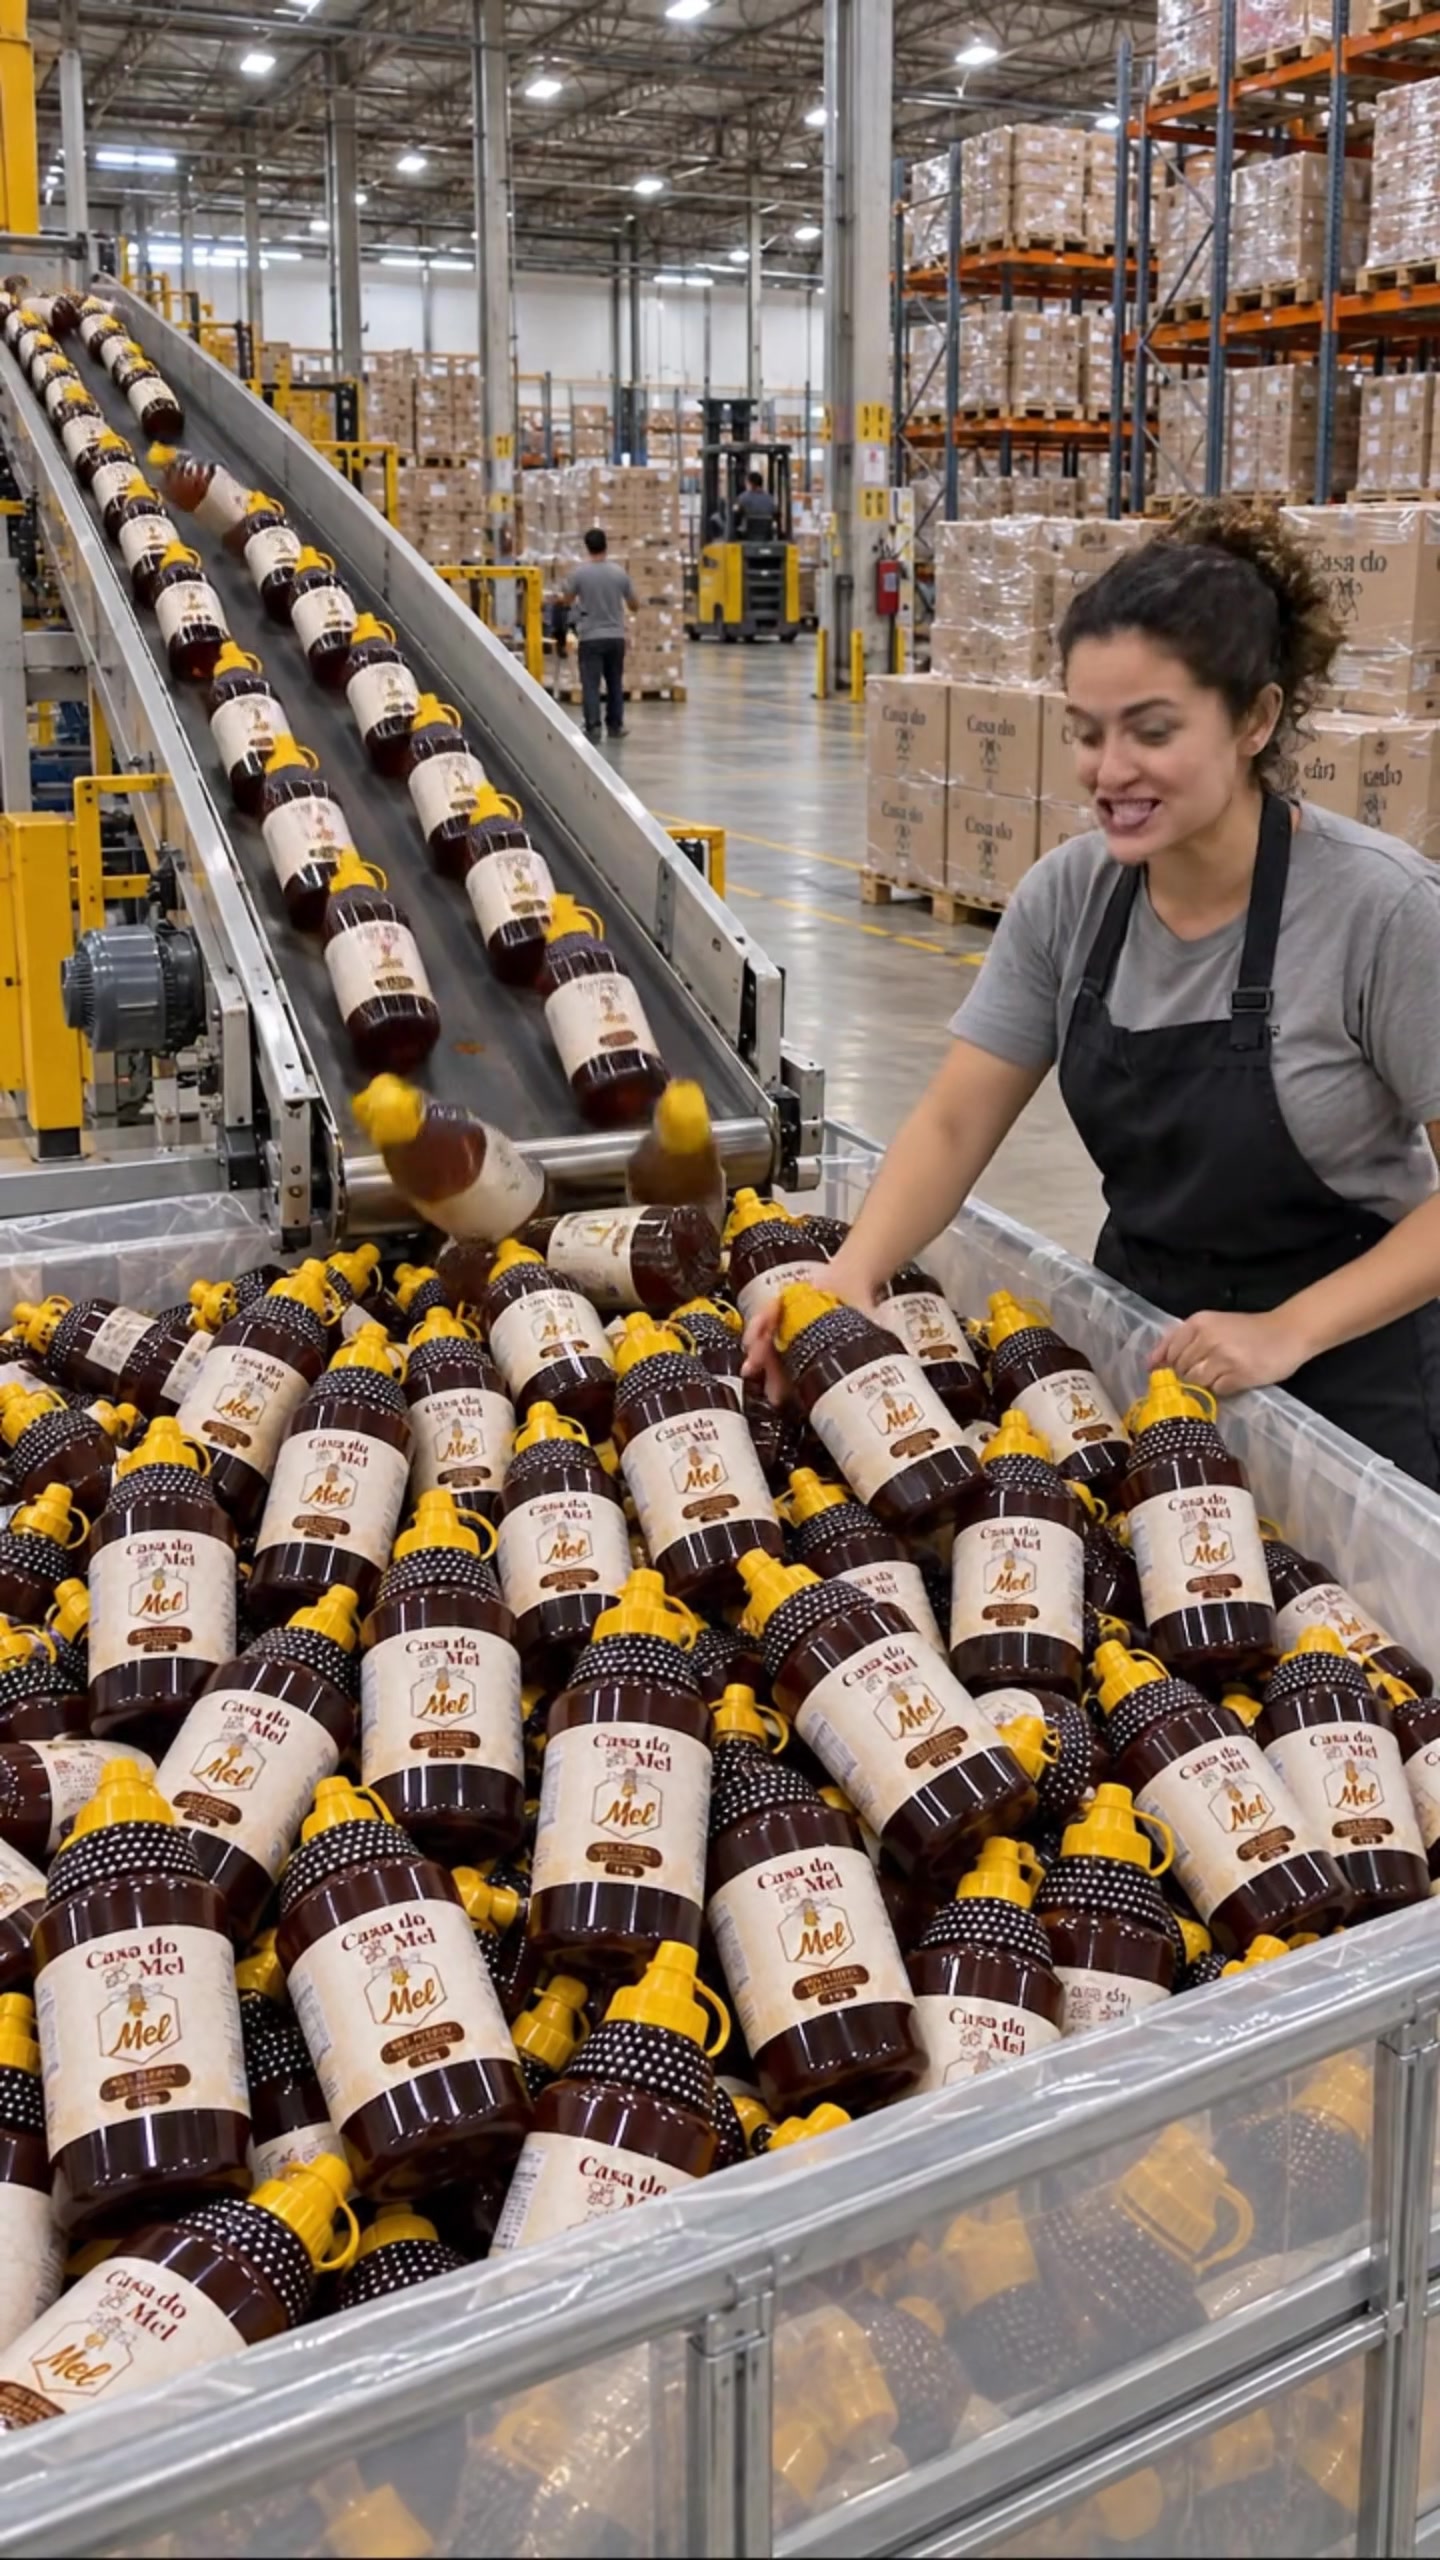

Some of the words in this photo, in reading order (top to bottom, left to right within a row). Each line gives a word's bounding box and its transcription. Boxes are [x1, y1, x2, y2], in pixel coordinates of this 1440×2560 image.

[1361, 549, 1387, 573] do
[683, 1463, 722, 1493] Mel
[304, 1484, 352, 1506] Mel
[545, 1538, 587, 1565] Mel
[1190, 1541, 1230, 1566] Mel
[989, 1571, 1031, 1594] Mel
[136, 1591, 184, 1617] Mel
[405, 1637, 449, 1654] Casa
[453, 1636, 478, 1650] do
[445, 1650, 480, 1667] Mel
[221, 1699, 262, 1719] Casa
[265, 1707, 291, 1729] do
[418, 1692, 469, 1719] Mel
[897, 1694, 937, 1738] Mel
[247, 1719, 288, 1745] Mel
[593, 1732, 641, 1750] Casa
[645, 1735, 670, 1754] do
[1309, 1732, 1350, 1747] Casa
[1353, 1730, 1374, 1745] do
[191, 1757, 254, 1787] Mel
[633, 1751, 672, 1773] Mel
[1334, 1783, 1378, 1808] Mel
[597, 1798, 656, 1828] Mel
[1229, 1794, 1268, 1832] Mel
[757, 1865, 805, 1890] Casa
[809, 1857, 835, 1873] do
[804, 1872, 844, 1893] Mel
[340, 1922, 393, 1952] Casa
[398, 1911, 426, 1930] do
[393, 1927, 437, 1952] Mel
[794, 1921, 846, 1962] Mel
[85, 1944, 141, 1971] Casa
[148, 1936, 178, 1955] do
[138, 1955, 186, 1977] Mel
[382, 1978, 437, 2024] Mel
[108, 2013, 172, 2058] Mel
[949, 2007, 997, 2029] Casa
[1002, 2017, 1026, 2037] do
[988, 2033, 1026, 2057] Mel
[578, 2155, 634, 2189] Casa
[105, 2269, 157, 2299] Casa
[157, 2292, 188, 2321] do
[126, 2302, 179, 2342] Mel
[31, 2344, 112, 2387] Mel
